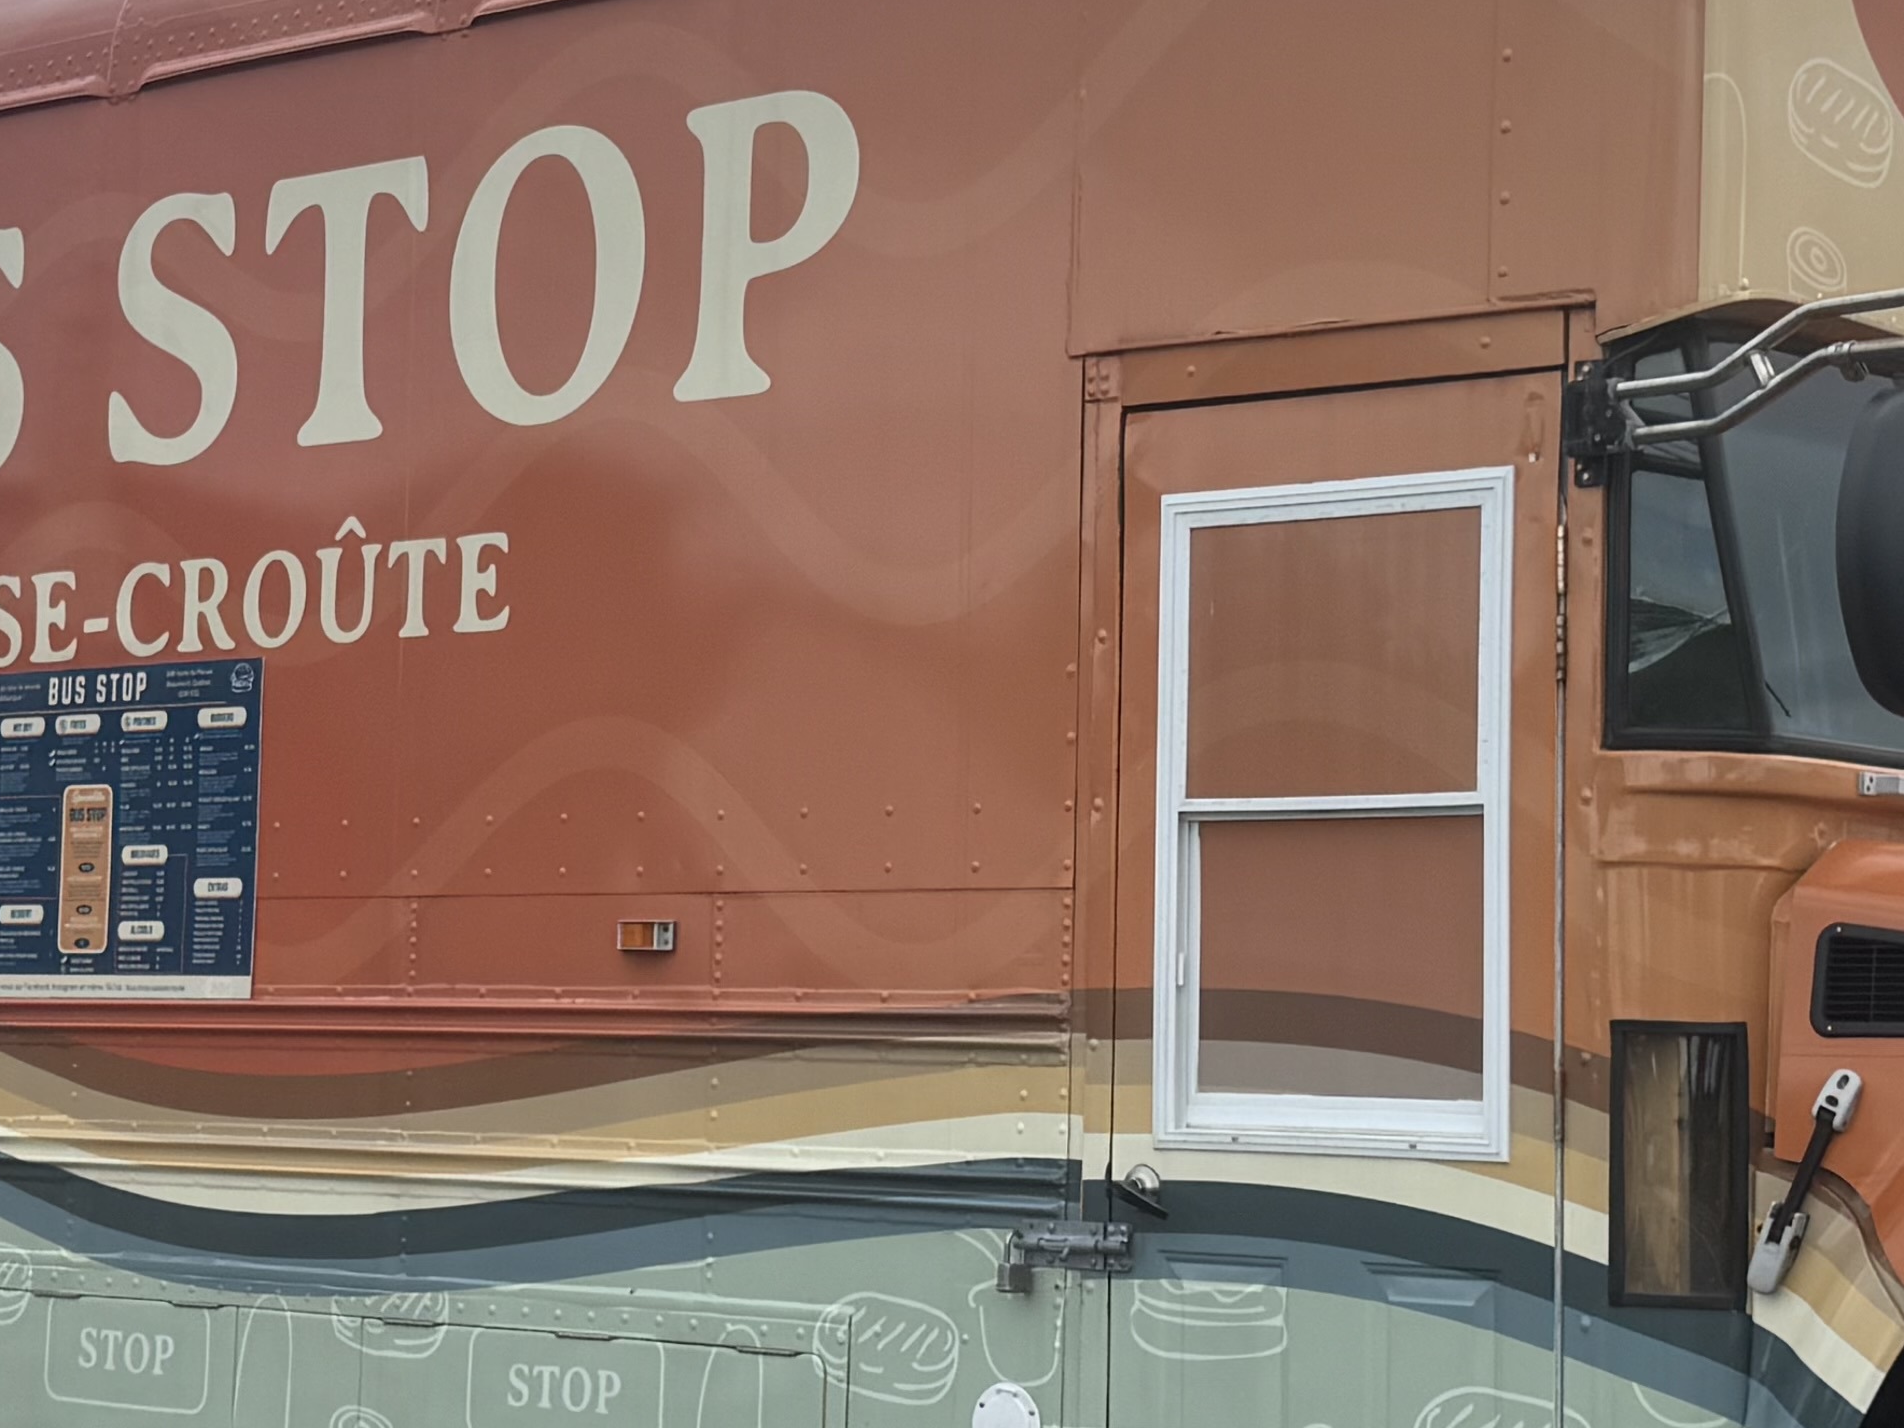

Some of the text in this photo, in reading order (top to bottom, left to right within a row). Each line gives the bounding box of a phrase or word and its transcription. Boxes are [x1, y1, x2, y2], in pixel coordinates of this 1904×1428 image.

[108, 89, 860, 465] STOP
[48, 676, 86, 705] BUS
[96, 671, 148, 703] STOP
[77, 1327, 175, 1376] STOP
[507, 1364, 621, 1415] STOP
